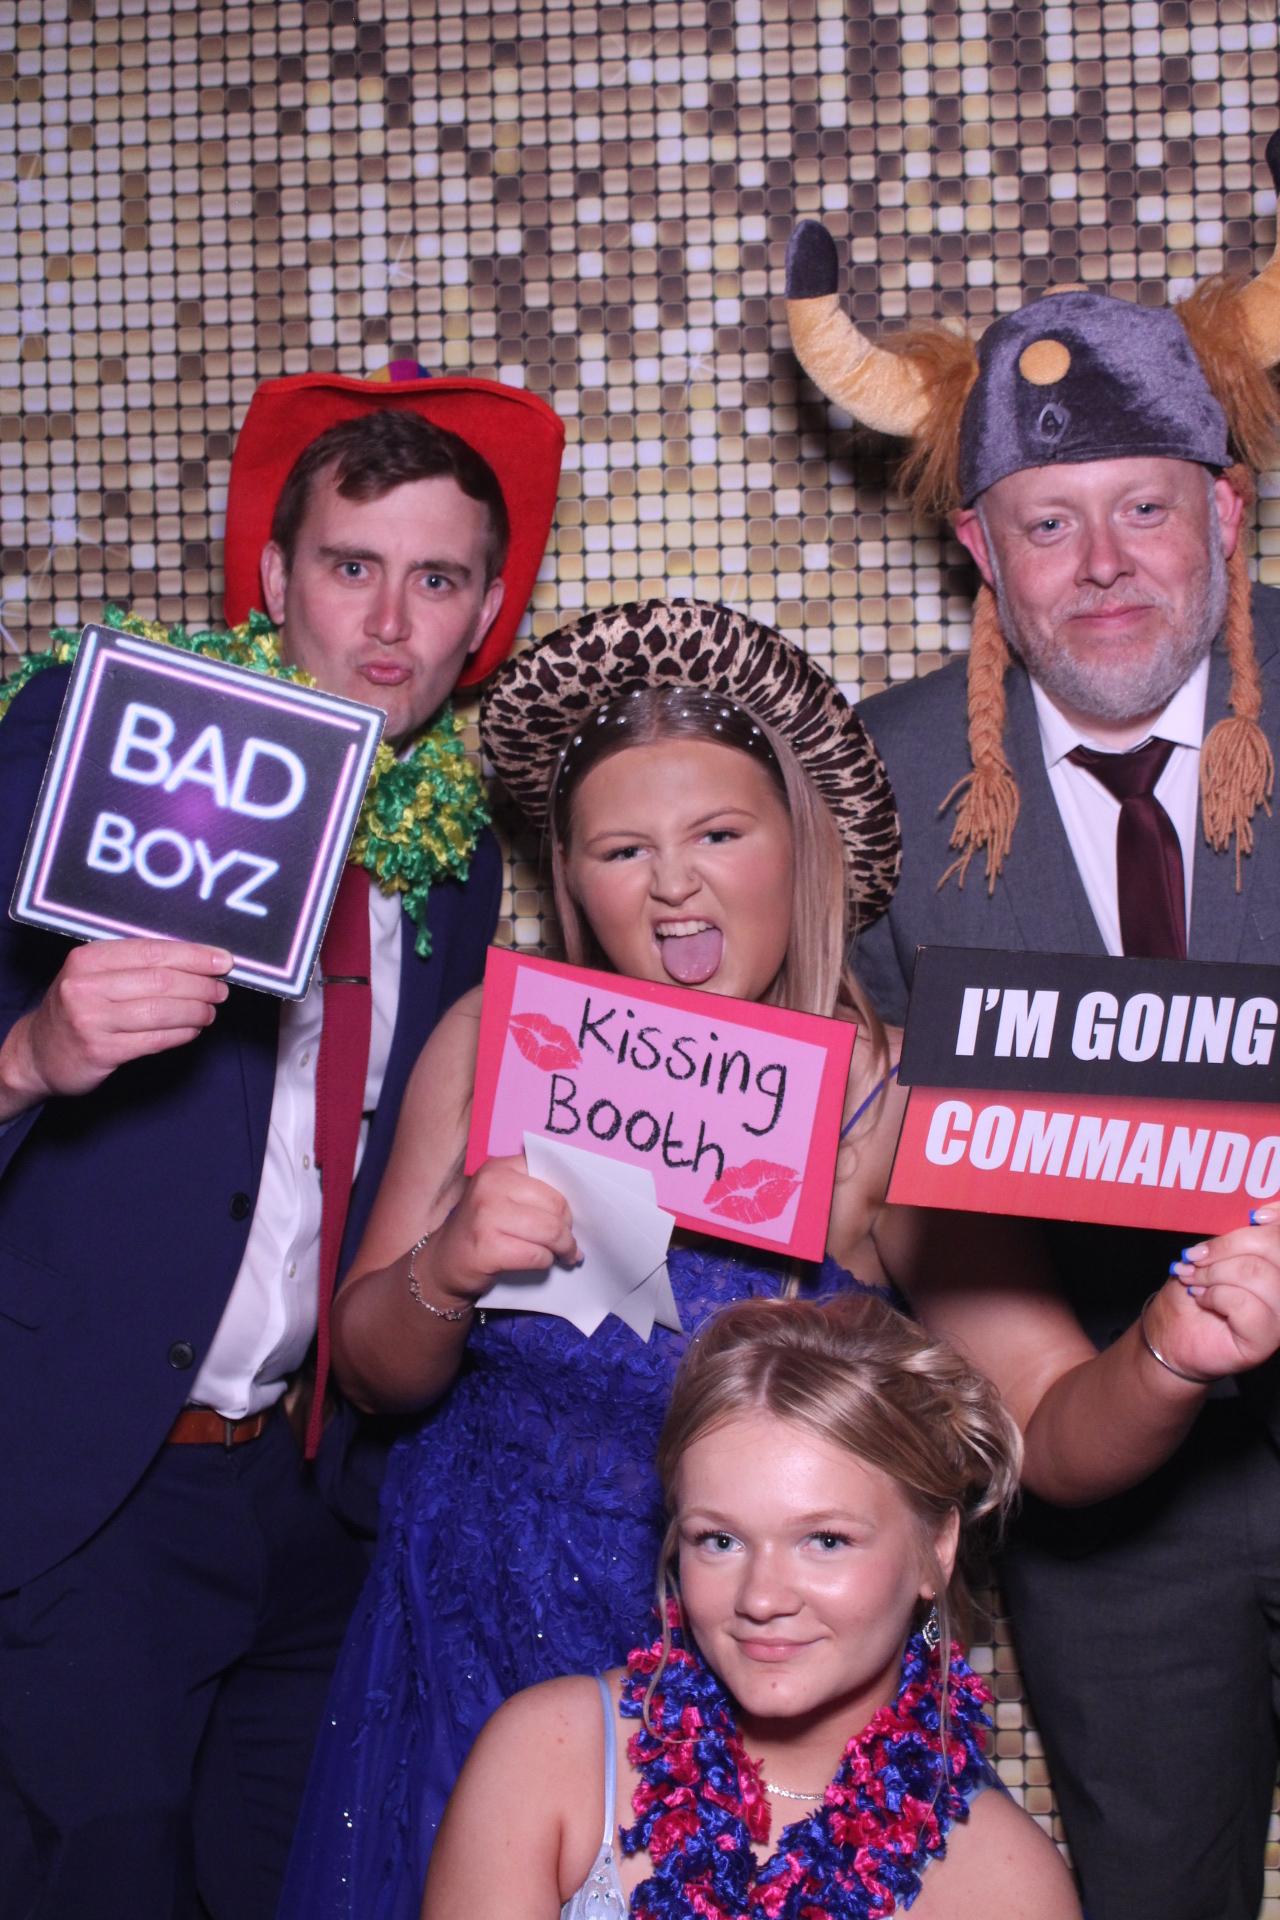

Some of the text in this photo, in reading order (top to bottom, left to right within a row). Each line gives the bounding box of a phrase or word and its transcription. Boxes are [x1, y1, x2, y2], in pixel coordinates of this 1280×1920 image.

[109, 701, 308, 821] BAD
[86, 811, 280, 918] BOYZ
[577, 997, 788, 1137] Kissing
[955, 987, 1279, 1066] I'M GOING
[544, 1073, 725, 1181] Booth
[924, 1100, 1280, 1199] COMMANDO
